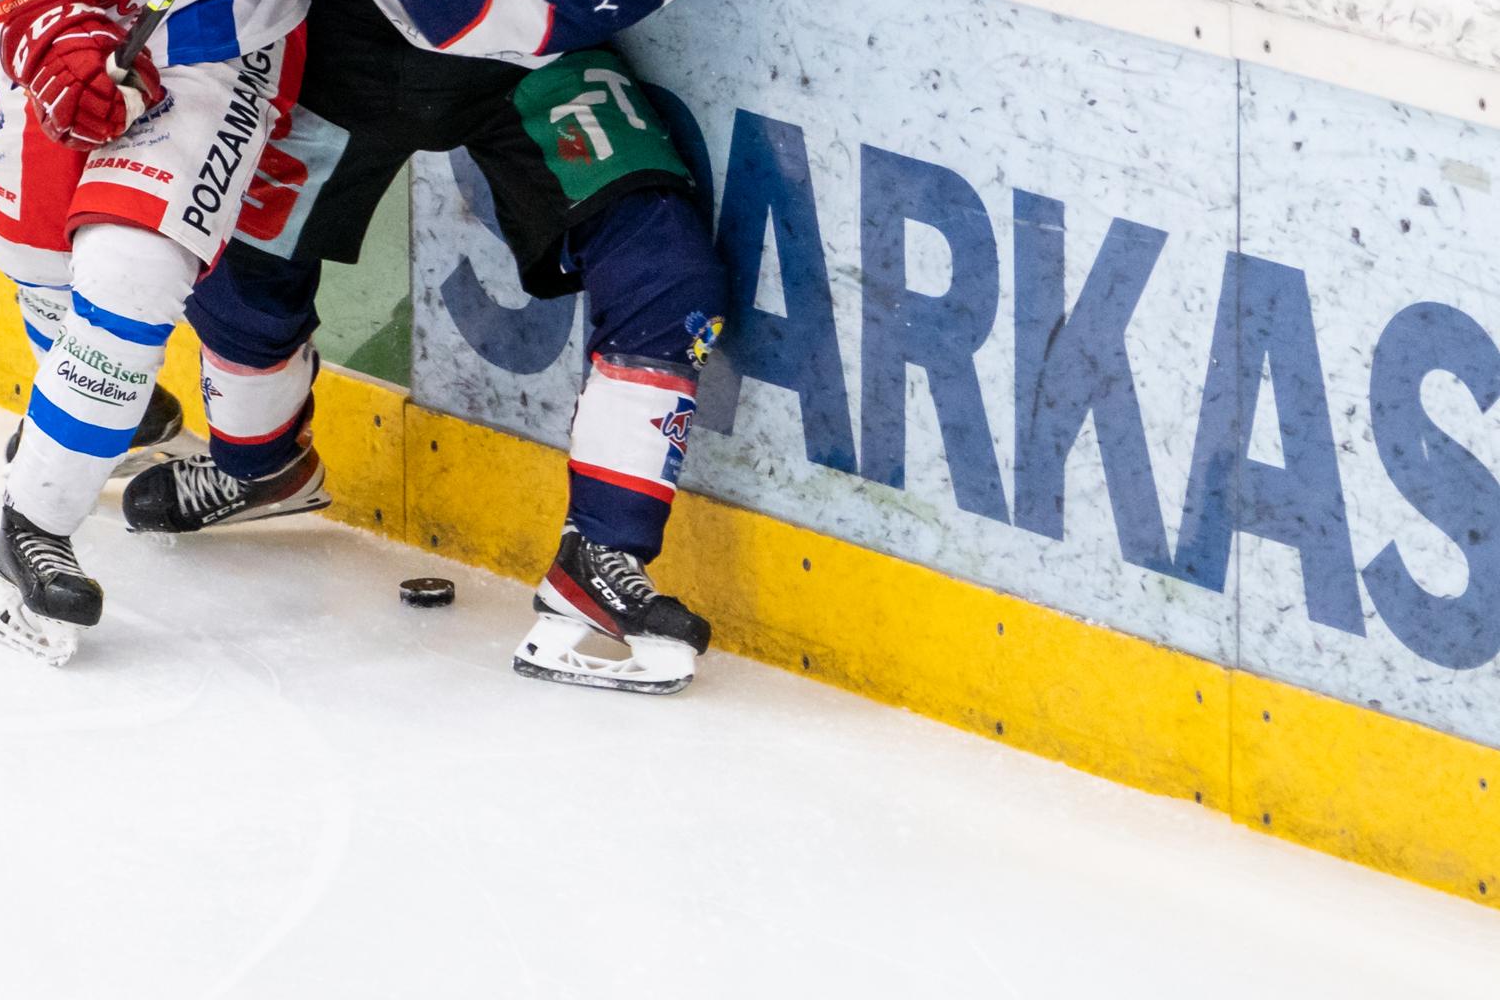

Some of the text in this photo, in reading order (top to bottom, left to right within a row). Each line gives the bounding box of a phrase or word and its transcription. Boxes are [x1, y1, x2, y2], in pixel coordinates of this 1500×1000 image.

[85, 156, 174, 185] ABANSER
[63, 335, 148, 386] Raiffeisen
[57, 360, 137, 402] Gherdëina
[202, 500, 246, 525] CCM
[590, 575, 627, 611] CCM
